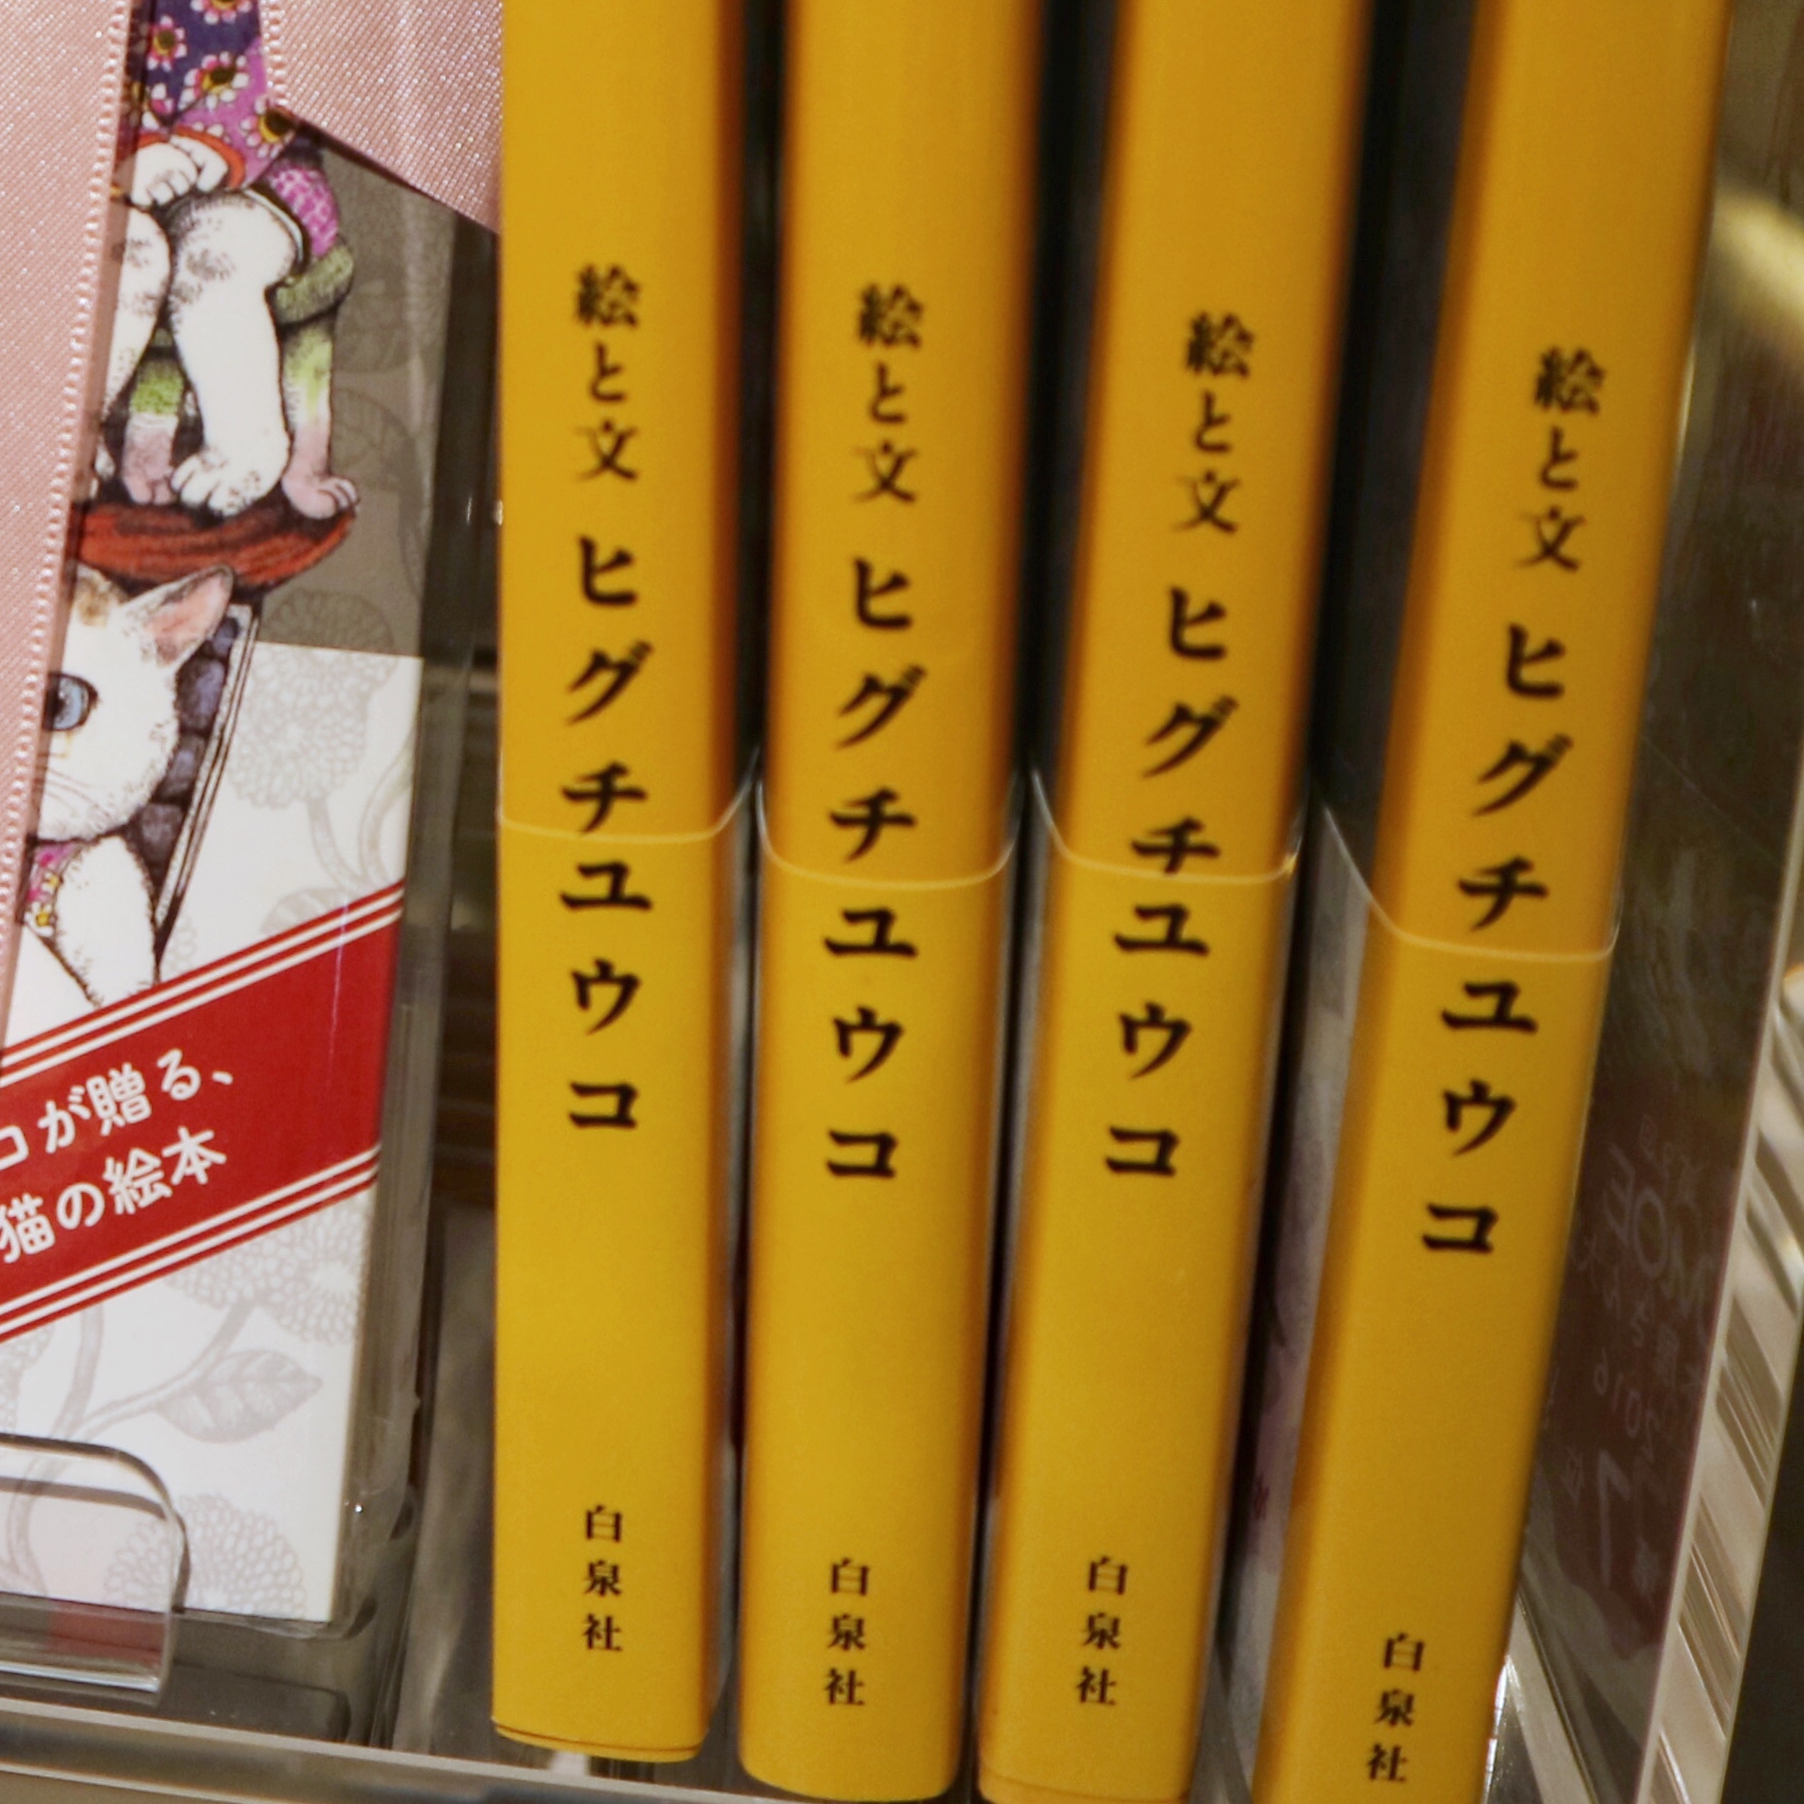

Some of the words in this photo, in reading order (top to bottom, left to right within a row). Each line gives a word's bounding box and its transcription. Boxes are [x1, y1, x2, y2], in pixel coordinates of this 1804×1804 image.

[574, 265, 640, 482] 絵と文
[855, 283, 924, 504] 絵と文
[1173, 311, 1255, 533] 絵と文
[1515, 345, 1606, 572] 絵と文
[559, 535, 653, 1128] ヒグチユウコ
[824, 558, 927, 1178] ヒグチユウコ
[1105, 587, 1238, 1176] ヒグチユウコ
[1422, 623, 1573, 1253] ヒグチユウコ
[583, 1504, 623, 1652] 白泉社
[825, 1558, 869, 1706] 白泉社
[1076, 1556, 1127, 1706] 白泉社
[1366, 1633, 1425, 1782] 白泉社
